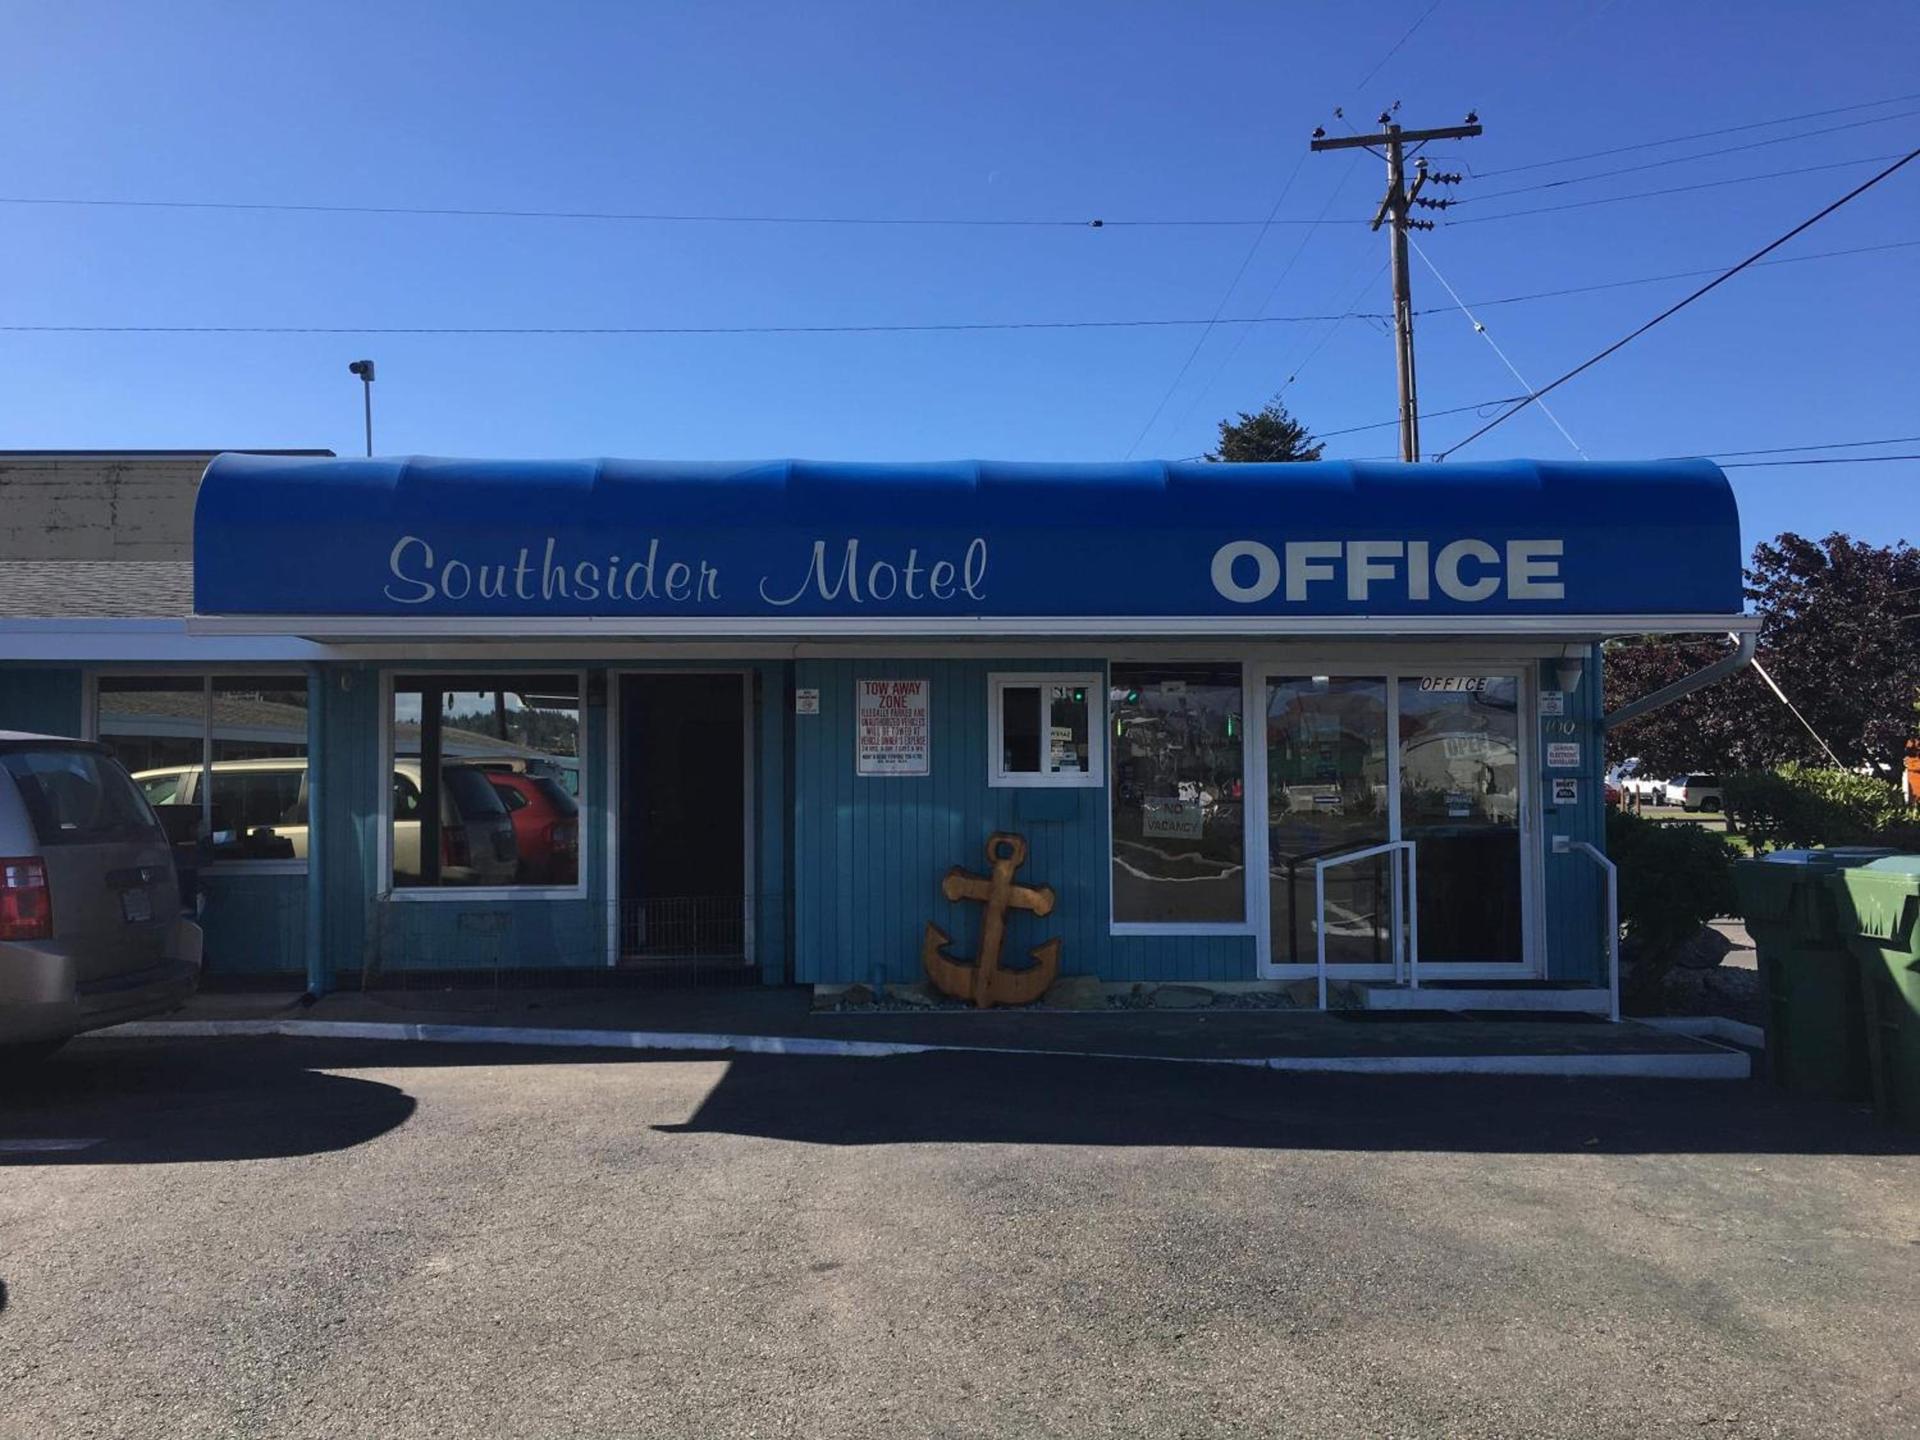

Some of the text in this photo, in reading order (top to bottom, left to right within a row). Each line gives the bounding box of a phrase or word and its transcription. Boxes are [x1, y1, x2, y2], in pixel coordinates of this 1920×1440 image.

[384, 536, 987, 606] Southsider Motel
[1210, 539, 1566, 603] OFFICE
[865, 682, 921, 695] TOW AWAY
[1421, 677, 1487, 691] OFFICE
[879, 695, 908, 708] ZONE
[1163, 803, 1183, 814] NO
[1147, 820, 1198, 833] VACANCY
